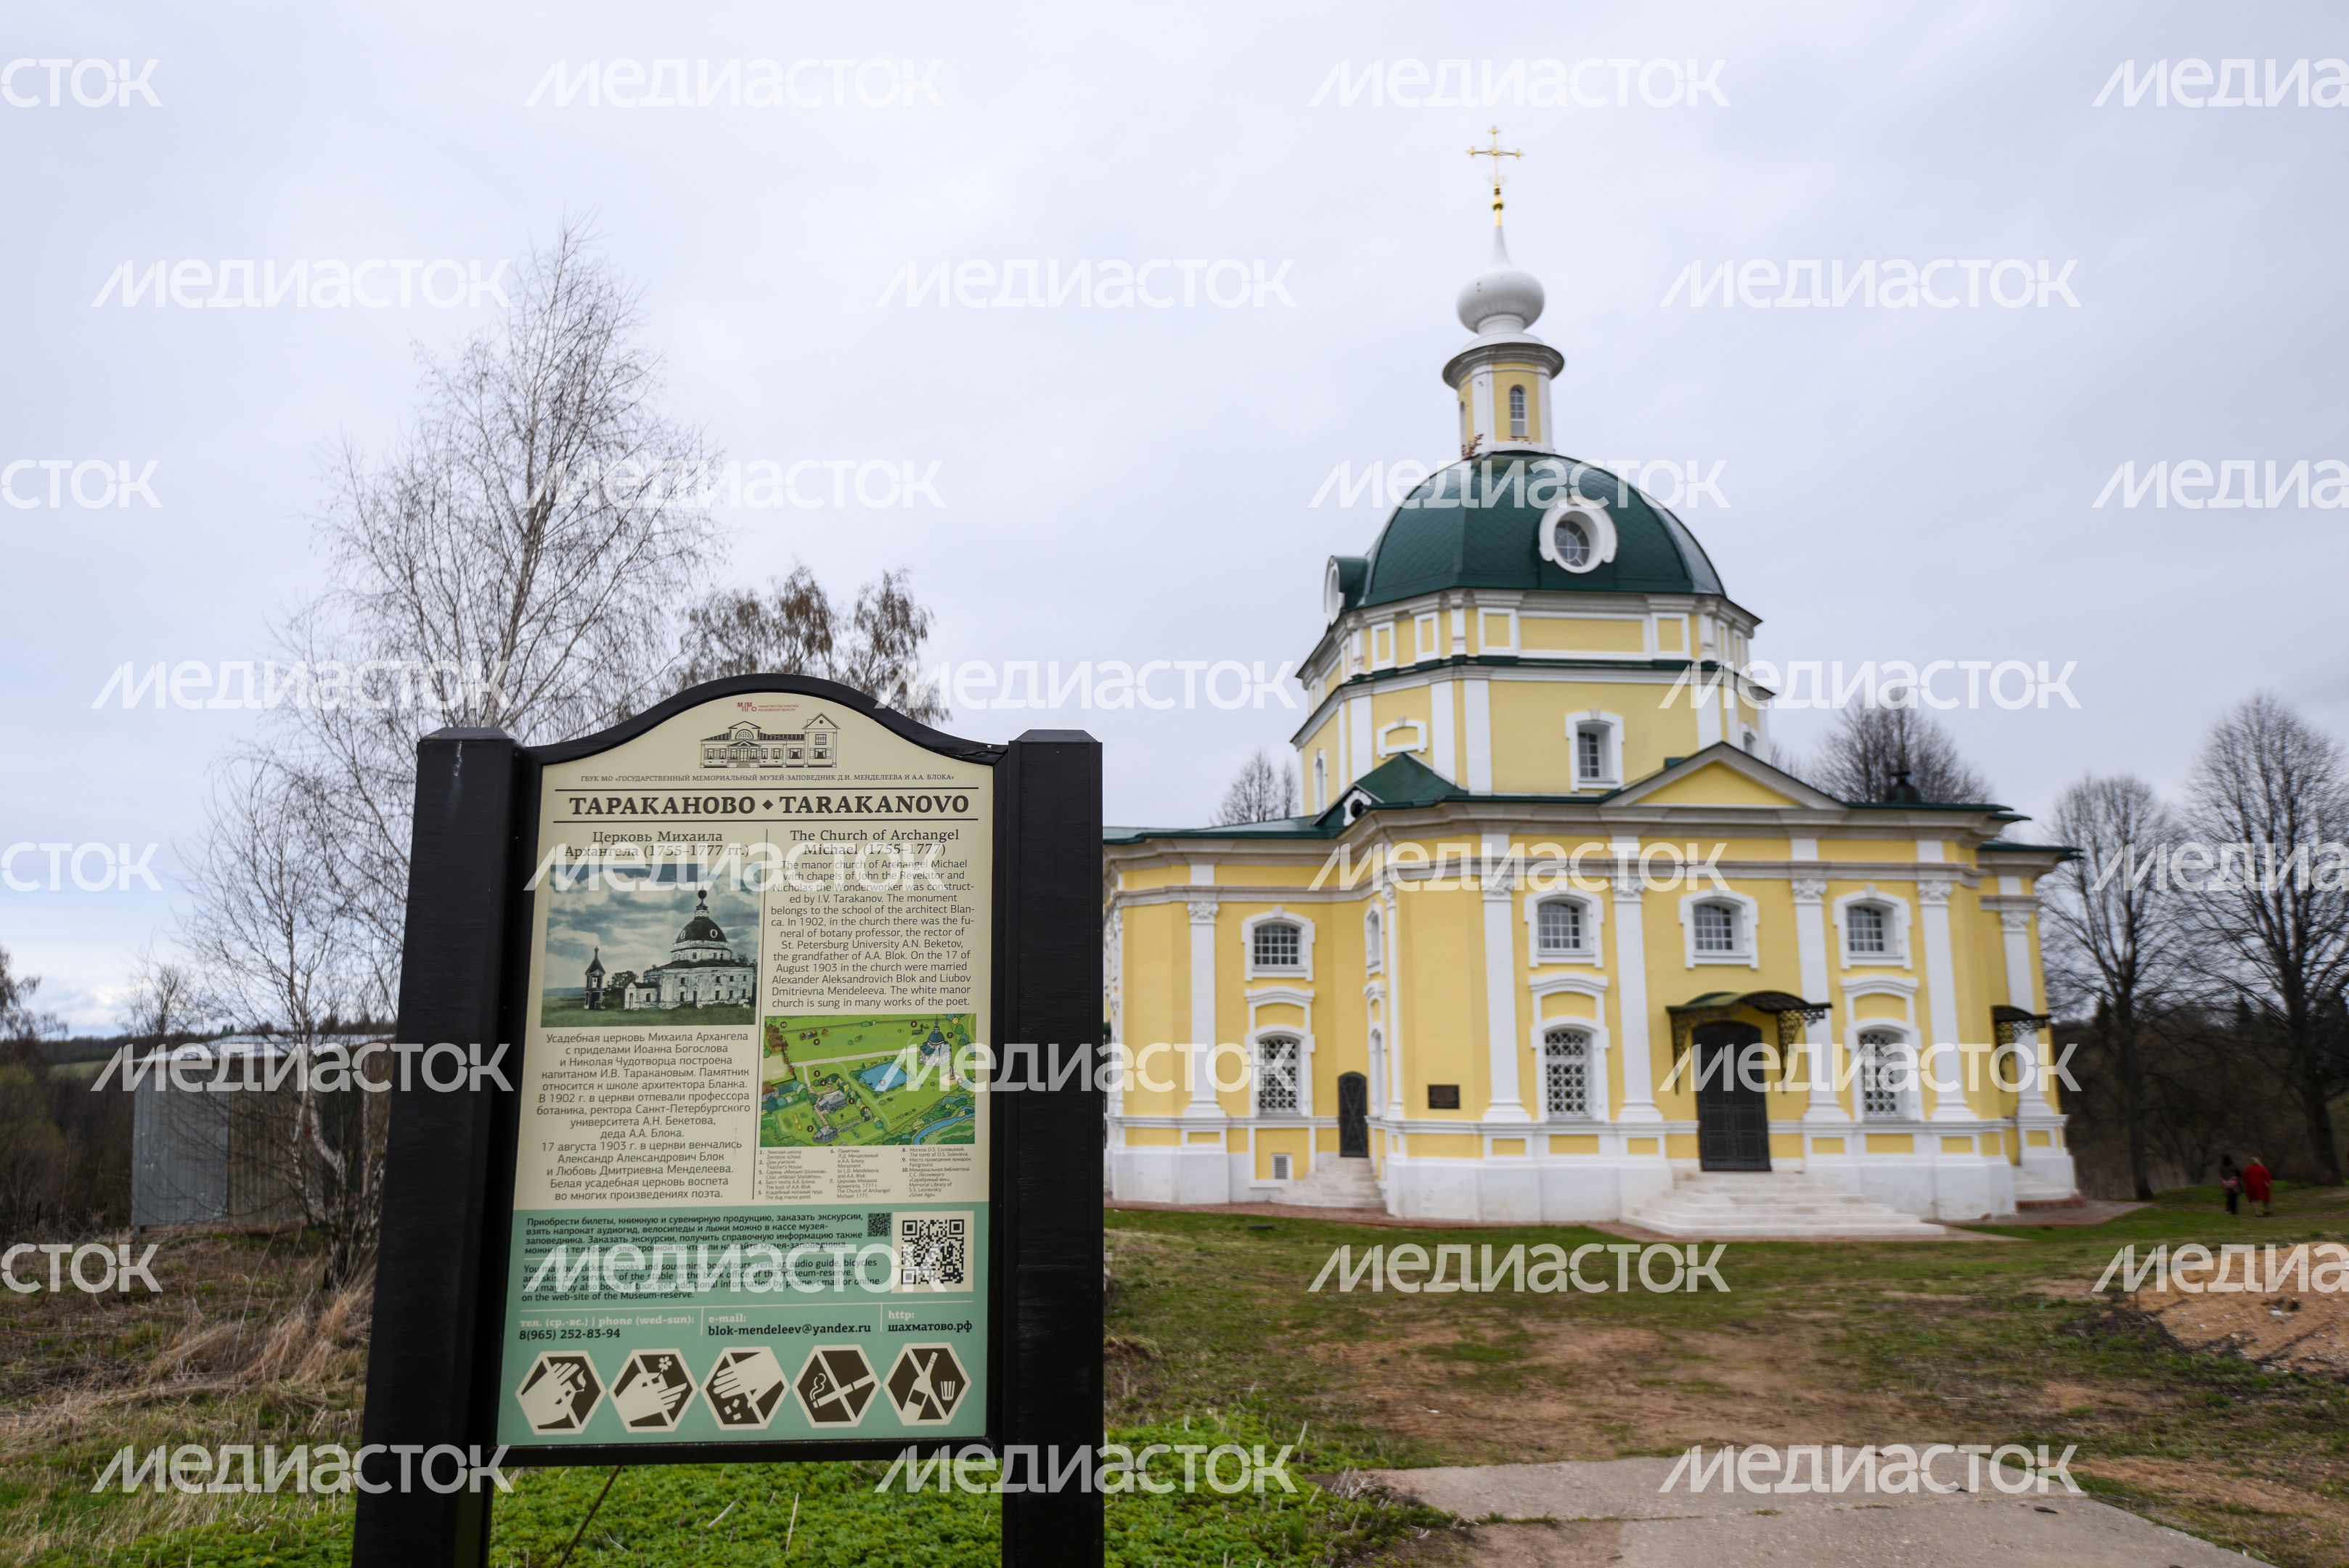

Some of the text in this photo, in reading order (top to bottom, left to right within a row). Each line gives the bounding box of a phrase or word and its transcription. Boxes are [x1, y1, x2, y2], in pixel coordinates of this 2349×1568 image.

[569, 796, 755, 814] ТАРАКАНОВО
[780, 796, 968, 814] TARAKANOVO
[592, 831, 723, 845] Церковь Михаила
[790, 829, 959, 844] The Church of Archangel
[790, 894, 801, 903] ed
[804, 894, 814, 905] by
[819, 894, 830, 903] I.V.
[886, 894, 904, 903] The
[771, 906, 807, 917] belongs
[842, 905, 871, 914] school
[875, 905, 885, 914] of
[887, 905, 902, 913] the
[906, 905, 947, 913] architect
[951, 905, 974, 914] Blan-
[807, 928, 817, 937] of
[820, 928, 852, 939] botany
[856, 928, 902, 939] professor,
[906, 928, 920, 936] the
[955, 927, 965, 936] of
[798, 940, 849, 952] Petersburg
[852, 940, 899, 951] University
[902, 939, 920, 949] A.N.
[925, 939, 963, 951] Beketov,
[772, 973, 971, 984] Alexander Aleksandrovich Blok and Liubov
[772, 987, 825, 996] Dmitrievna
[828, 986, 886, 995] Mendeleeva.
[890, 986, 907, 995] The
[911, 985, 936, 995] white
[772, 998, 804, 1008] church
[817, 1000, 840, 1009] sung
[855, 1000, 881, 1008] many
[884, 997, 912, 1006] works
[915, 997, 925, 1005] of
[928, 997, 943, 1005] the
[947, 997, 969, 1008] poet.
[547, 1034, 600, 1044] Усадебная
[603, 1035, 645, 1044] церковь
[695, 1032, 748, 1042] Архангела
[575, 1047, 630, 1056] приделами
[634, 1045, 672, 1053] Иоанна
[675, 1044, 728, 1053] Богослова
[616, 1057, 676, 1068] Чудотворца
[679, 1058, 732, 1066] построена
[624, 1069, 695, 1079] Таракановым.
[642, 1082, 705, 1092] архитектора
[537, 1104, 750, 1116] ботаника, ректора Санкт-Петербургского
[528, 1217, 579, 1228] Приобрести
[669, 1217, 720, 1225] сувенирную
[723, 1215, 774, 1224] продукцию,
[817, 1214, 862, 1222] экскурсии,
[552, 1292, 589, 1301] web-site
[621, 1289, 697, 1299] Museum-reserve.
[708, 1323, 871, 1336] blok-mendeleev@yandex.ru
[888, 1320, 972, 1333] шахматово.рф
[520, 1328, 620, 1342] 8(965) 252-83-94
